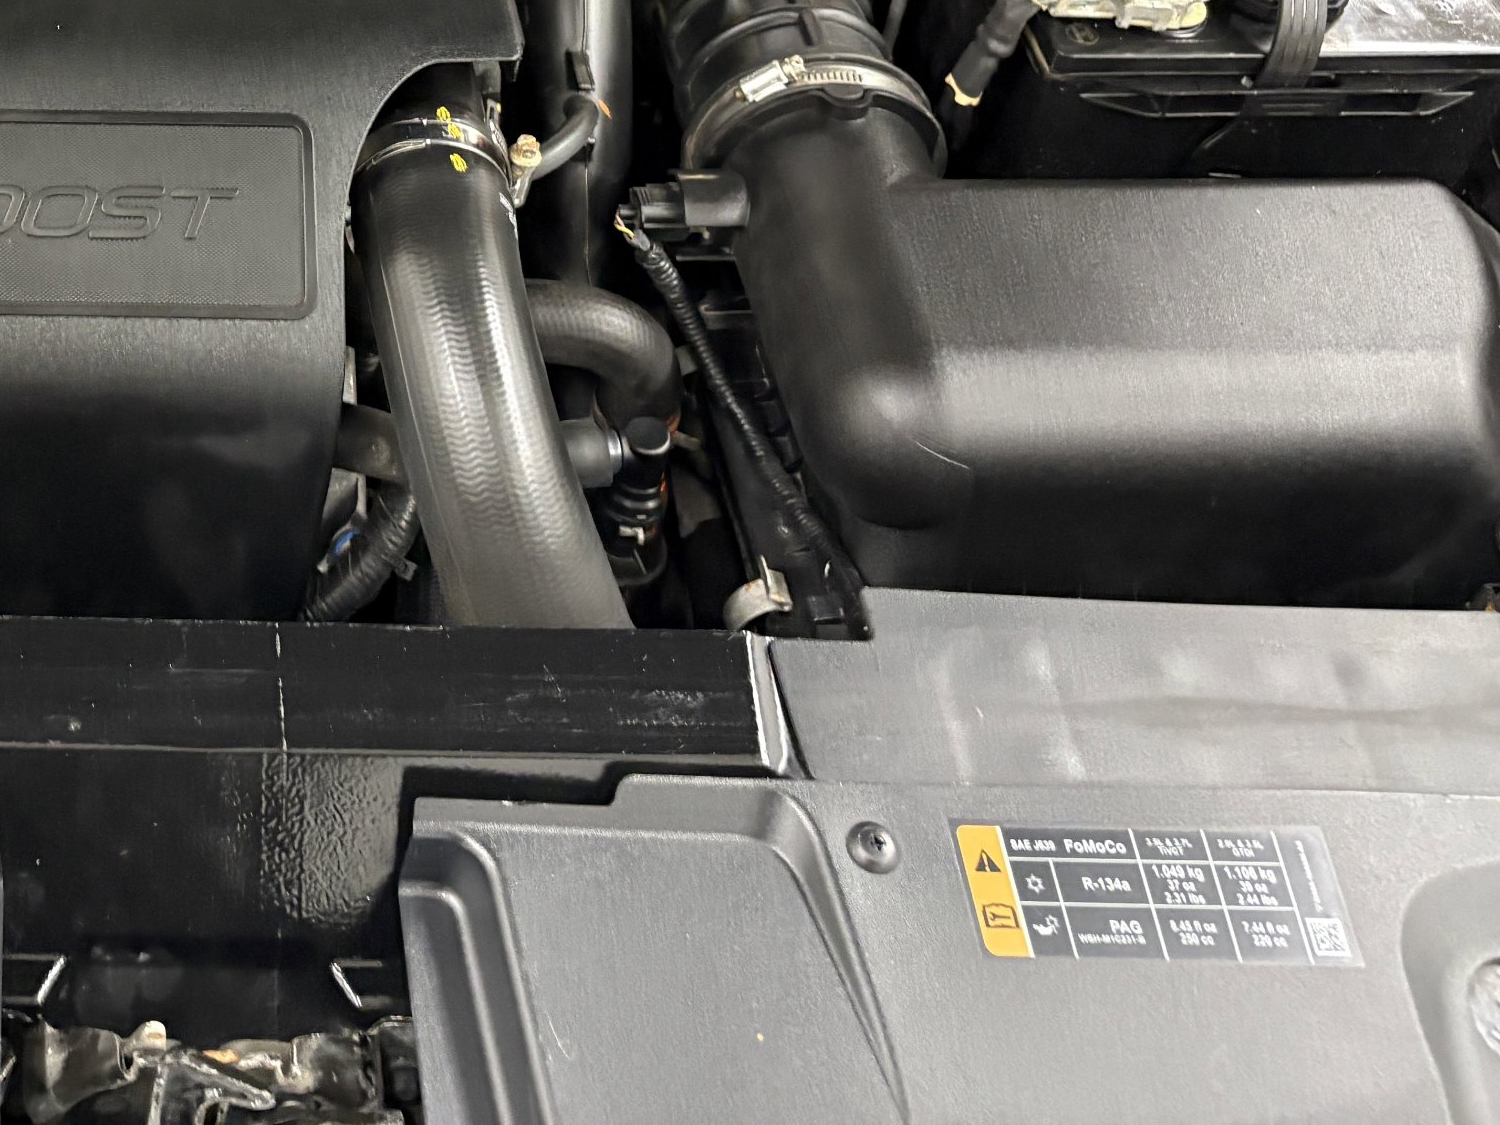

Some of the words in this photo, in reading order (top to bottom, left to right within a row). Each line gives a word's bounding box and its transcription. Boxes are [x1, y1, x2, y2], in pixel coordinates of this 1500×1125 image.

[1063, 838, 1127, 854] FoMoCo
[1152, 864, 1186, 879] 1.049
[1186, 865, 1205, 882] kg
[1258, 867, 1277, 884] kg
[1081, 876, 1132, 892] R-134a
[1167, 879, 1180, 892] 37
[1182, 881, 1197, 892] oz
[1254, 882, 1270, 894] oz
[1188, 892, 1206, 905] lbs
[1260, 894, 1279, 906] lbs
[1109, 919, 1144, 934] PAG
[1203, 922, 1218, 934] oz
[1275, 924, 1291, 936] oz
